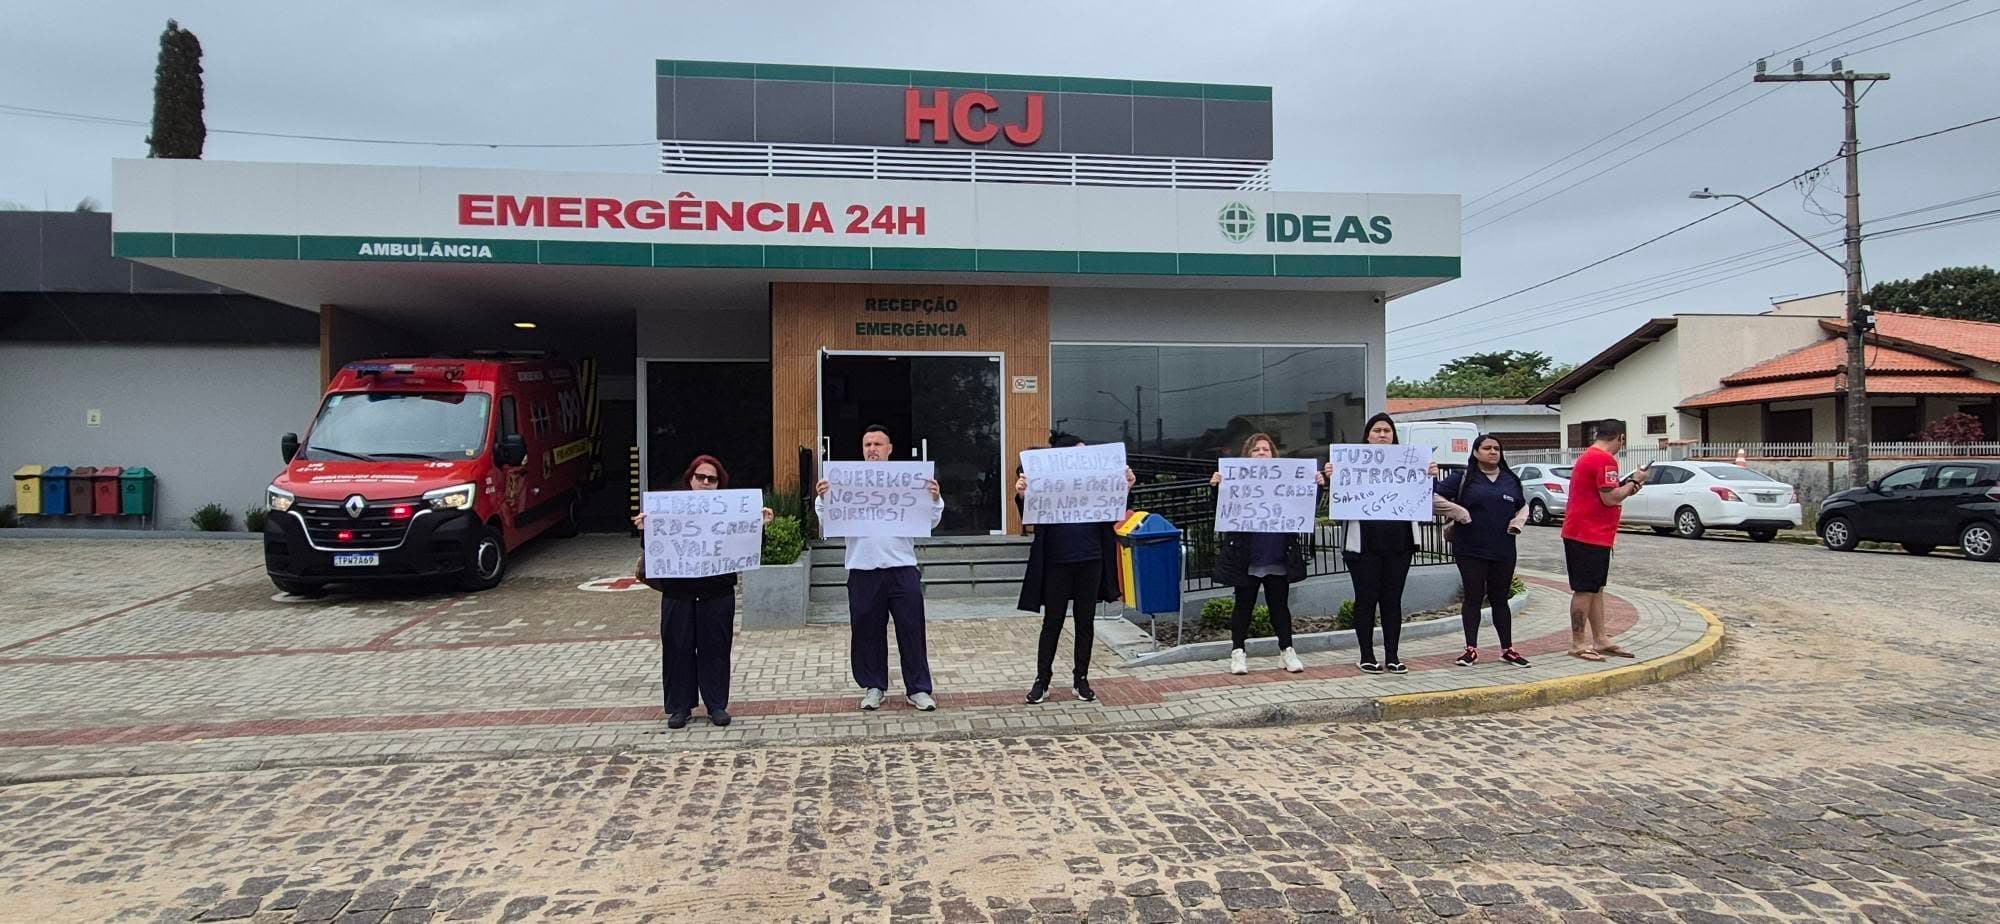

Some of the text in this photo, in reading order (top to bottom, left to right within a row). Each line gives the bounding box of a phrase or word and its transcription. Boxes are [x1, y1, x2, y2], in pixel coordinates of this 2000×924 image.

[905, 88, 1045, 146] HCJ
[458, 191, 926, 235] EMERGÊNCIA 24H
[1266, 212, 1393, 245] IDEAS
[358, 241, 493, 258] AMBULÂNCIA
[864, 296, 959, 315] RECEPÇÃO
[855, 320, 967, 337] EMERGÊNCIA
[1333, 448, 1385, 465] TUDO
[828, 467, 929, 489] QUEREMOS
[1224, 465, 1305, 480] IDEAS E
[829, 488, 917, 508] NOSSOS
[1229, 484, 1264, 499] RDS
[1332, 490, 1374, 504] SALARIO
[649, 495, 750, 515] IDEAS E
[1220, 501, 1283, 520] NOSSO
[1361, 491, 1399, 516] FGTS
[651, 519, 702, 537] RDS
[671, 539, 723, 557] VALE
